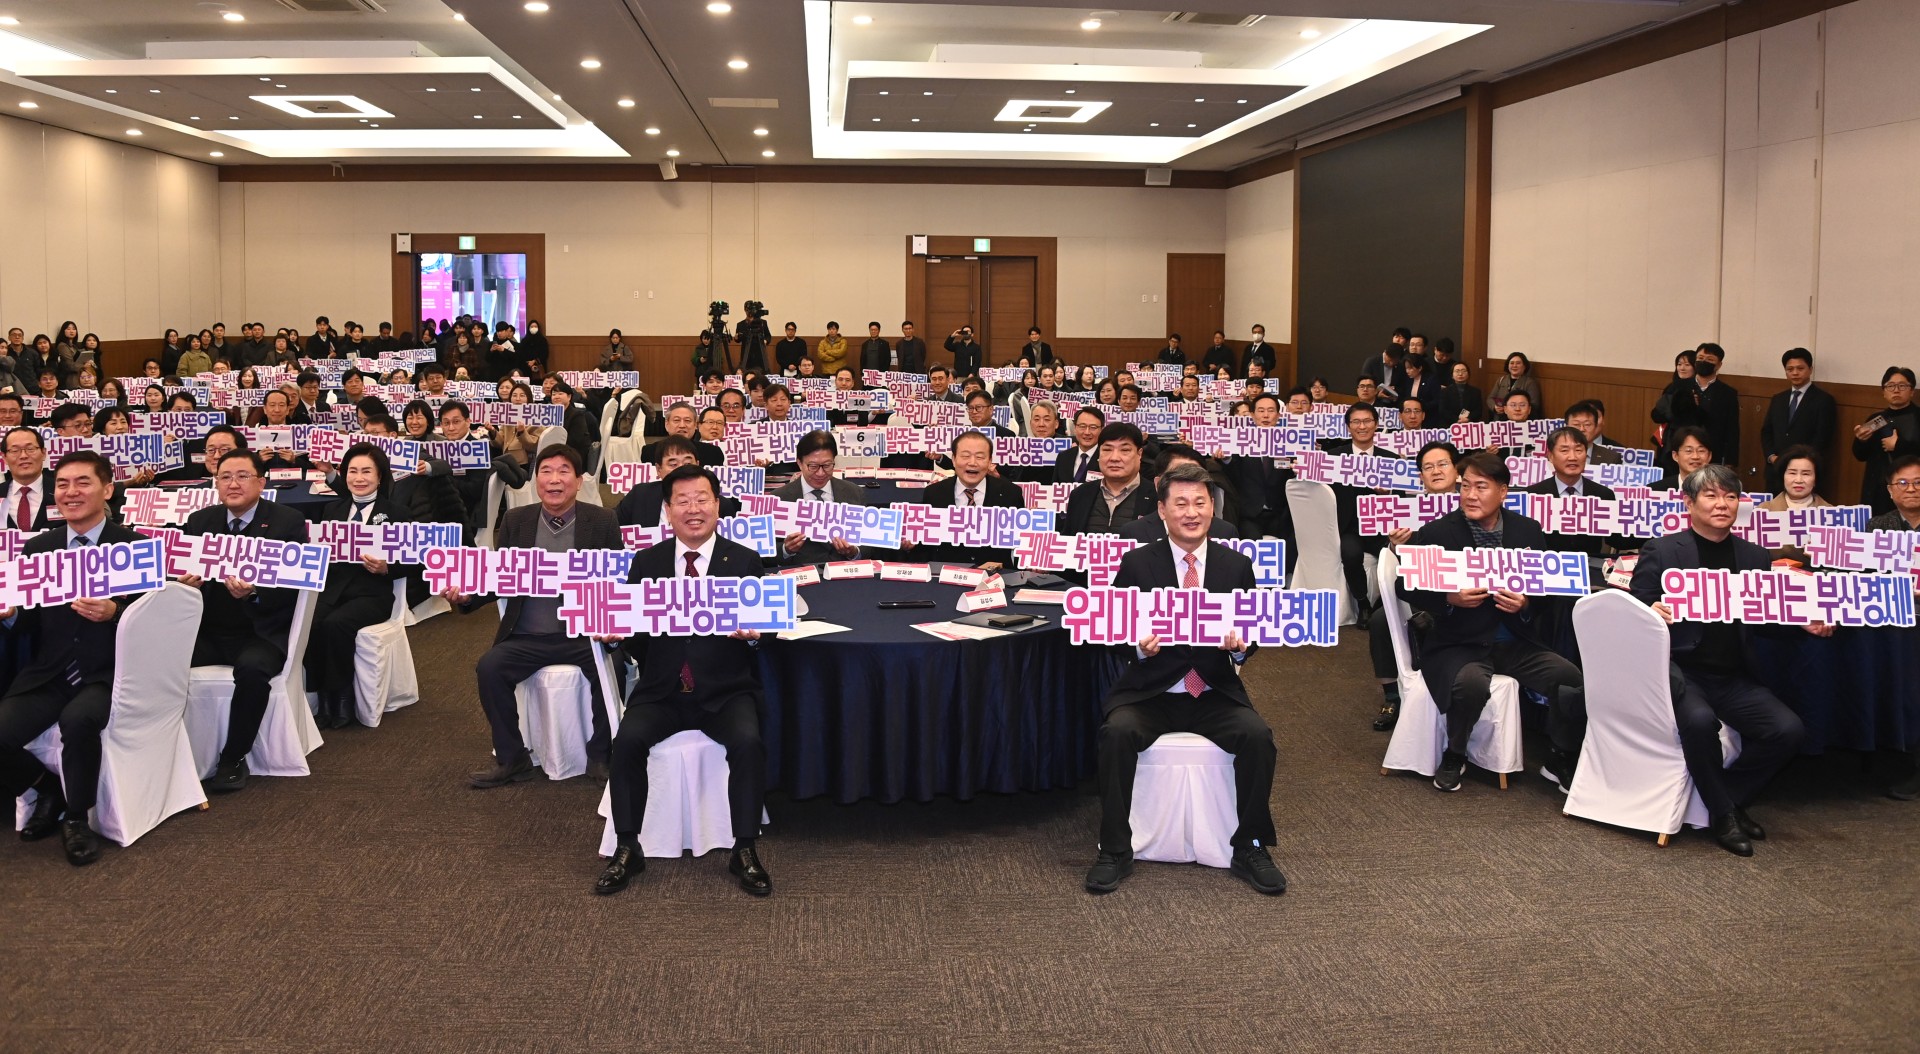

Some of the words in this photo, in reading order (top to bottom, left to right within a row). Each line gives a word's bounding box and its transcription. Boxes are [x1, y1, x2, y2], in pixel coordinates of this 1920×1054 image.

[582, 373, 603, 387] 살리는
[607, 373, 638, 387] 부산경제!
[863, 370, 882, 386] 구매는
[211, 390, 232, 406] 구매는
[236, 389, 267, 406] 부산상품
[432, 398, 441, 406] 11
[808, 391, 832, 409] 발주는
[854, 399, 865, 407] 10
[467, 403, 485, 423] 리가
[489, 402, 518, 425] 살리는
[522, 405, 563, 427] 부산경제!
[905, 403, 933, 425] 우리가
[937, 404, 965, 426] 살리는
[100, 434, 163, 466] 부산경제!
[270, 432, 279, 443] 7
[310, 429, 344, 463] 발주는
[857, 431, 865, 442] 6
[887, 428, 920, 453] 발주는
[1194, 428, 1231, 455] 발주는
[1237, 428, 1315, 456] 부산기업으로!
[1393, 430, 1451, 455] 부산기업으
[1451, 422, 1485, 448] 우리가
[1489, 421, 1523, 446] 살리는
[1528, 420, 1565, 439] 부산경
[725, 438, 763, 466] 살리는
[996, 438, 1071, 465] 부산상품으로!
[1293, 450, 1334, 482] 구매는
[609, 462, 650, 493] 우리가
[706, 466, 764, 497] 산경제!
[1507, 456, 1546, 486] 우리가
[122, 489, 168, 524] 구매는
[1359, 496, 1410, 534] 발주는
[1560, 496, 1610, 534] 살리는
[622, 525, 657, 550] 주는
[795, 500, 900, 548] 부산상품으로!
[948, 506, 1054, 547] 부산기업으로!
[319, 522, 373, 561] 살리는
[1016, 532, 1068, 569] 구매는
[1807, 527, 1865, 569] 구매는
[17, 539, 163, 606] 부산기업으로!
[199, 534, 329, 590] 부산상품으로!
[425, 548, 487, 593] 우리가
[496, 549, 559, 595] 살리는
[567, 551, 634, 584] 부산경
[1089, 540, 1136, 586] 발주
[1399, 547, 1457, 590] 구매는
[1467, 549, 1589, 595] 부산상품으로!
[560, 580, 631, 635] 구매는
[643, 577, 794, 634] 부산상품으로!
[1664, 571, 1730, 621] 우리가
[1740, 572, 1807, 623] 살리는
[1817, 575, 1914, 626] 부산경제!
[1065, 589, 1139, 643] 우리가
[1150, 590, 1222, 643] 살리는
[1233, 591, 1336, 644] 부산경제!
